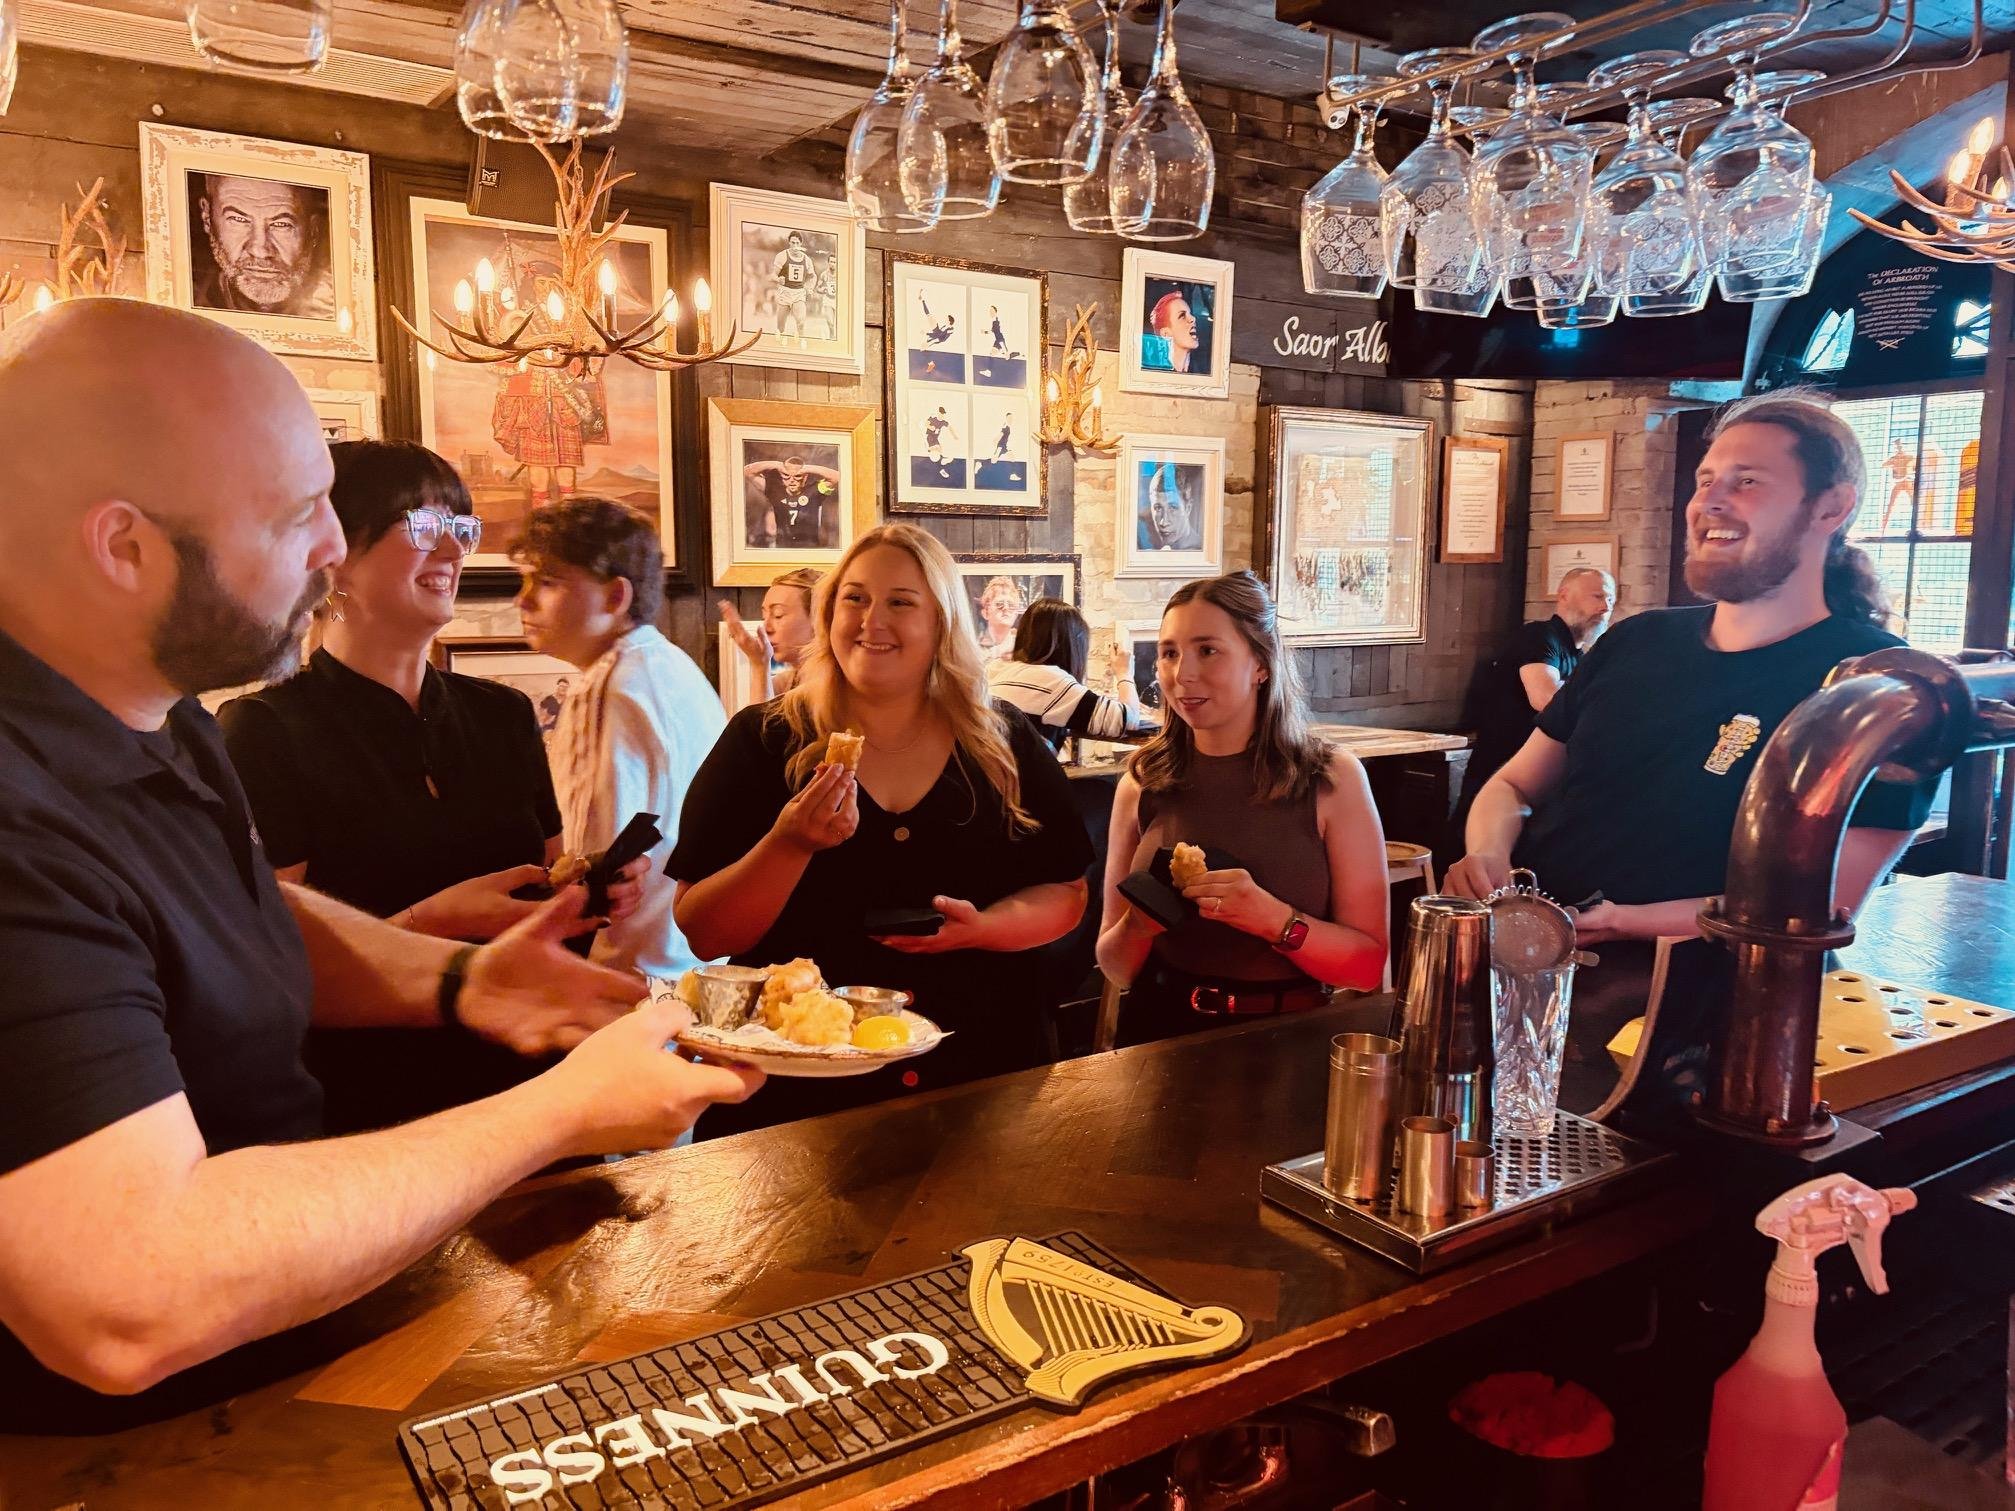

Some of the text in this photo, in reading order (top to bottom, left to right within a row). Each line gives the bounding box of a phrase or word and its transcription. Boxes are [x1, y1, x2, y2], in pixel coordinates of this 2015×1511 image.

[793, 268, 800, 280] 5
[1273, 316, 1339, 359] Saor
[788, 510, 799, 526] 7
[490, 1332, 949, 1503] GUINNESS
